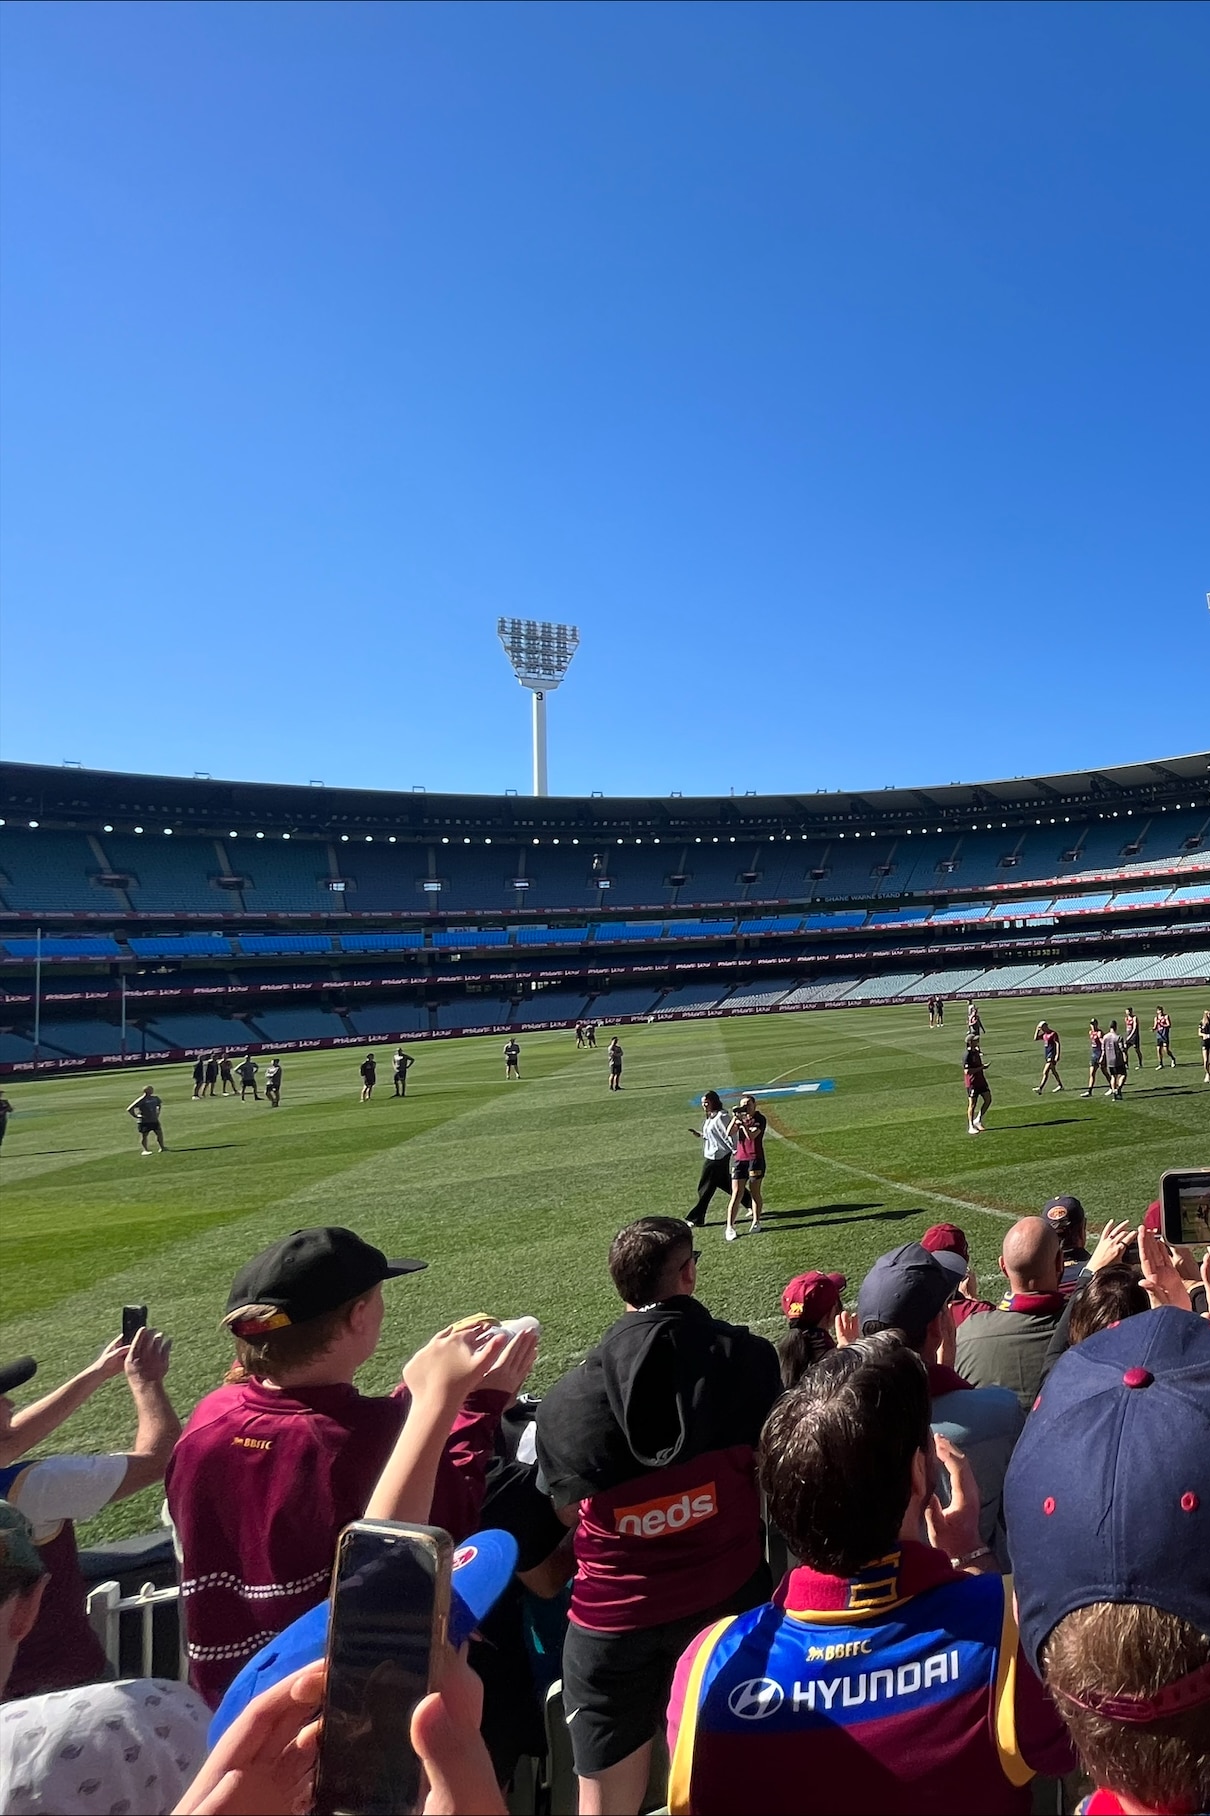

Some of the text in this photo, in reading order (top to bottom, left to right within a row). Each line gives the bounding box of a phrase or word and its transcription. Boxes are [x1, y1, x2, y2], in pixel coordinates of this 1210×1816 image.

[618, 1494, 714, 1536] neds
[824, 1639, 873, 1661] BBFFC
[792, 1650, 959, 1712] HYUNDAI
